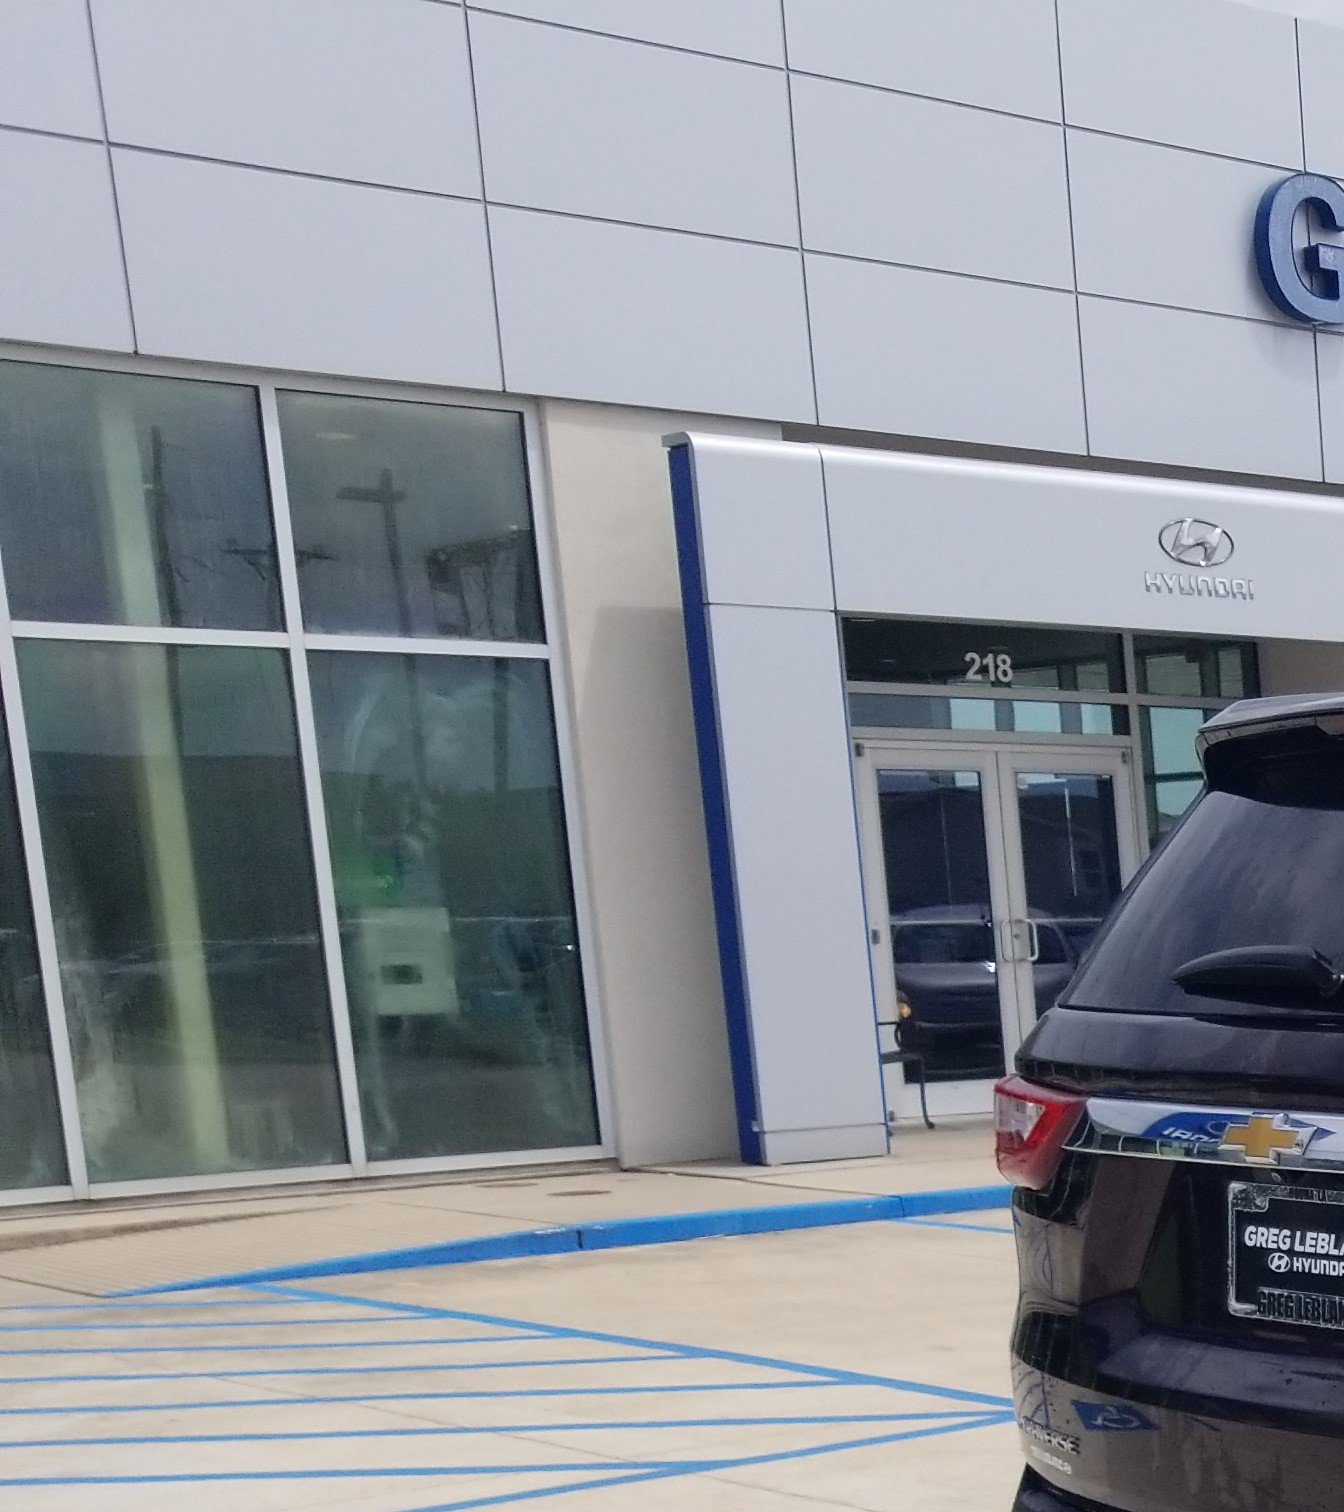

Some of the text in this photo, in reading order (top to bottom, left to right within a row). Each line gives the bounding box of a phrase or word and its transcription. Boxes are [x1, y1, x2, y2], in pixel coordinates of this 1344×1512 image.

[1143, 571, 1255, 601] HYUNDAI
[963, 651, 1014, 684] 218
[1243, 1225, 1291, 1251] GREG
